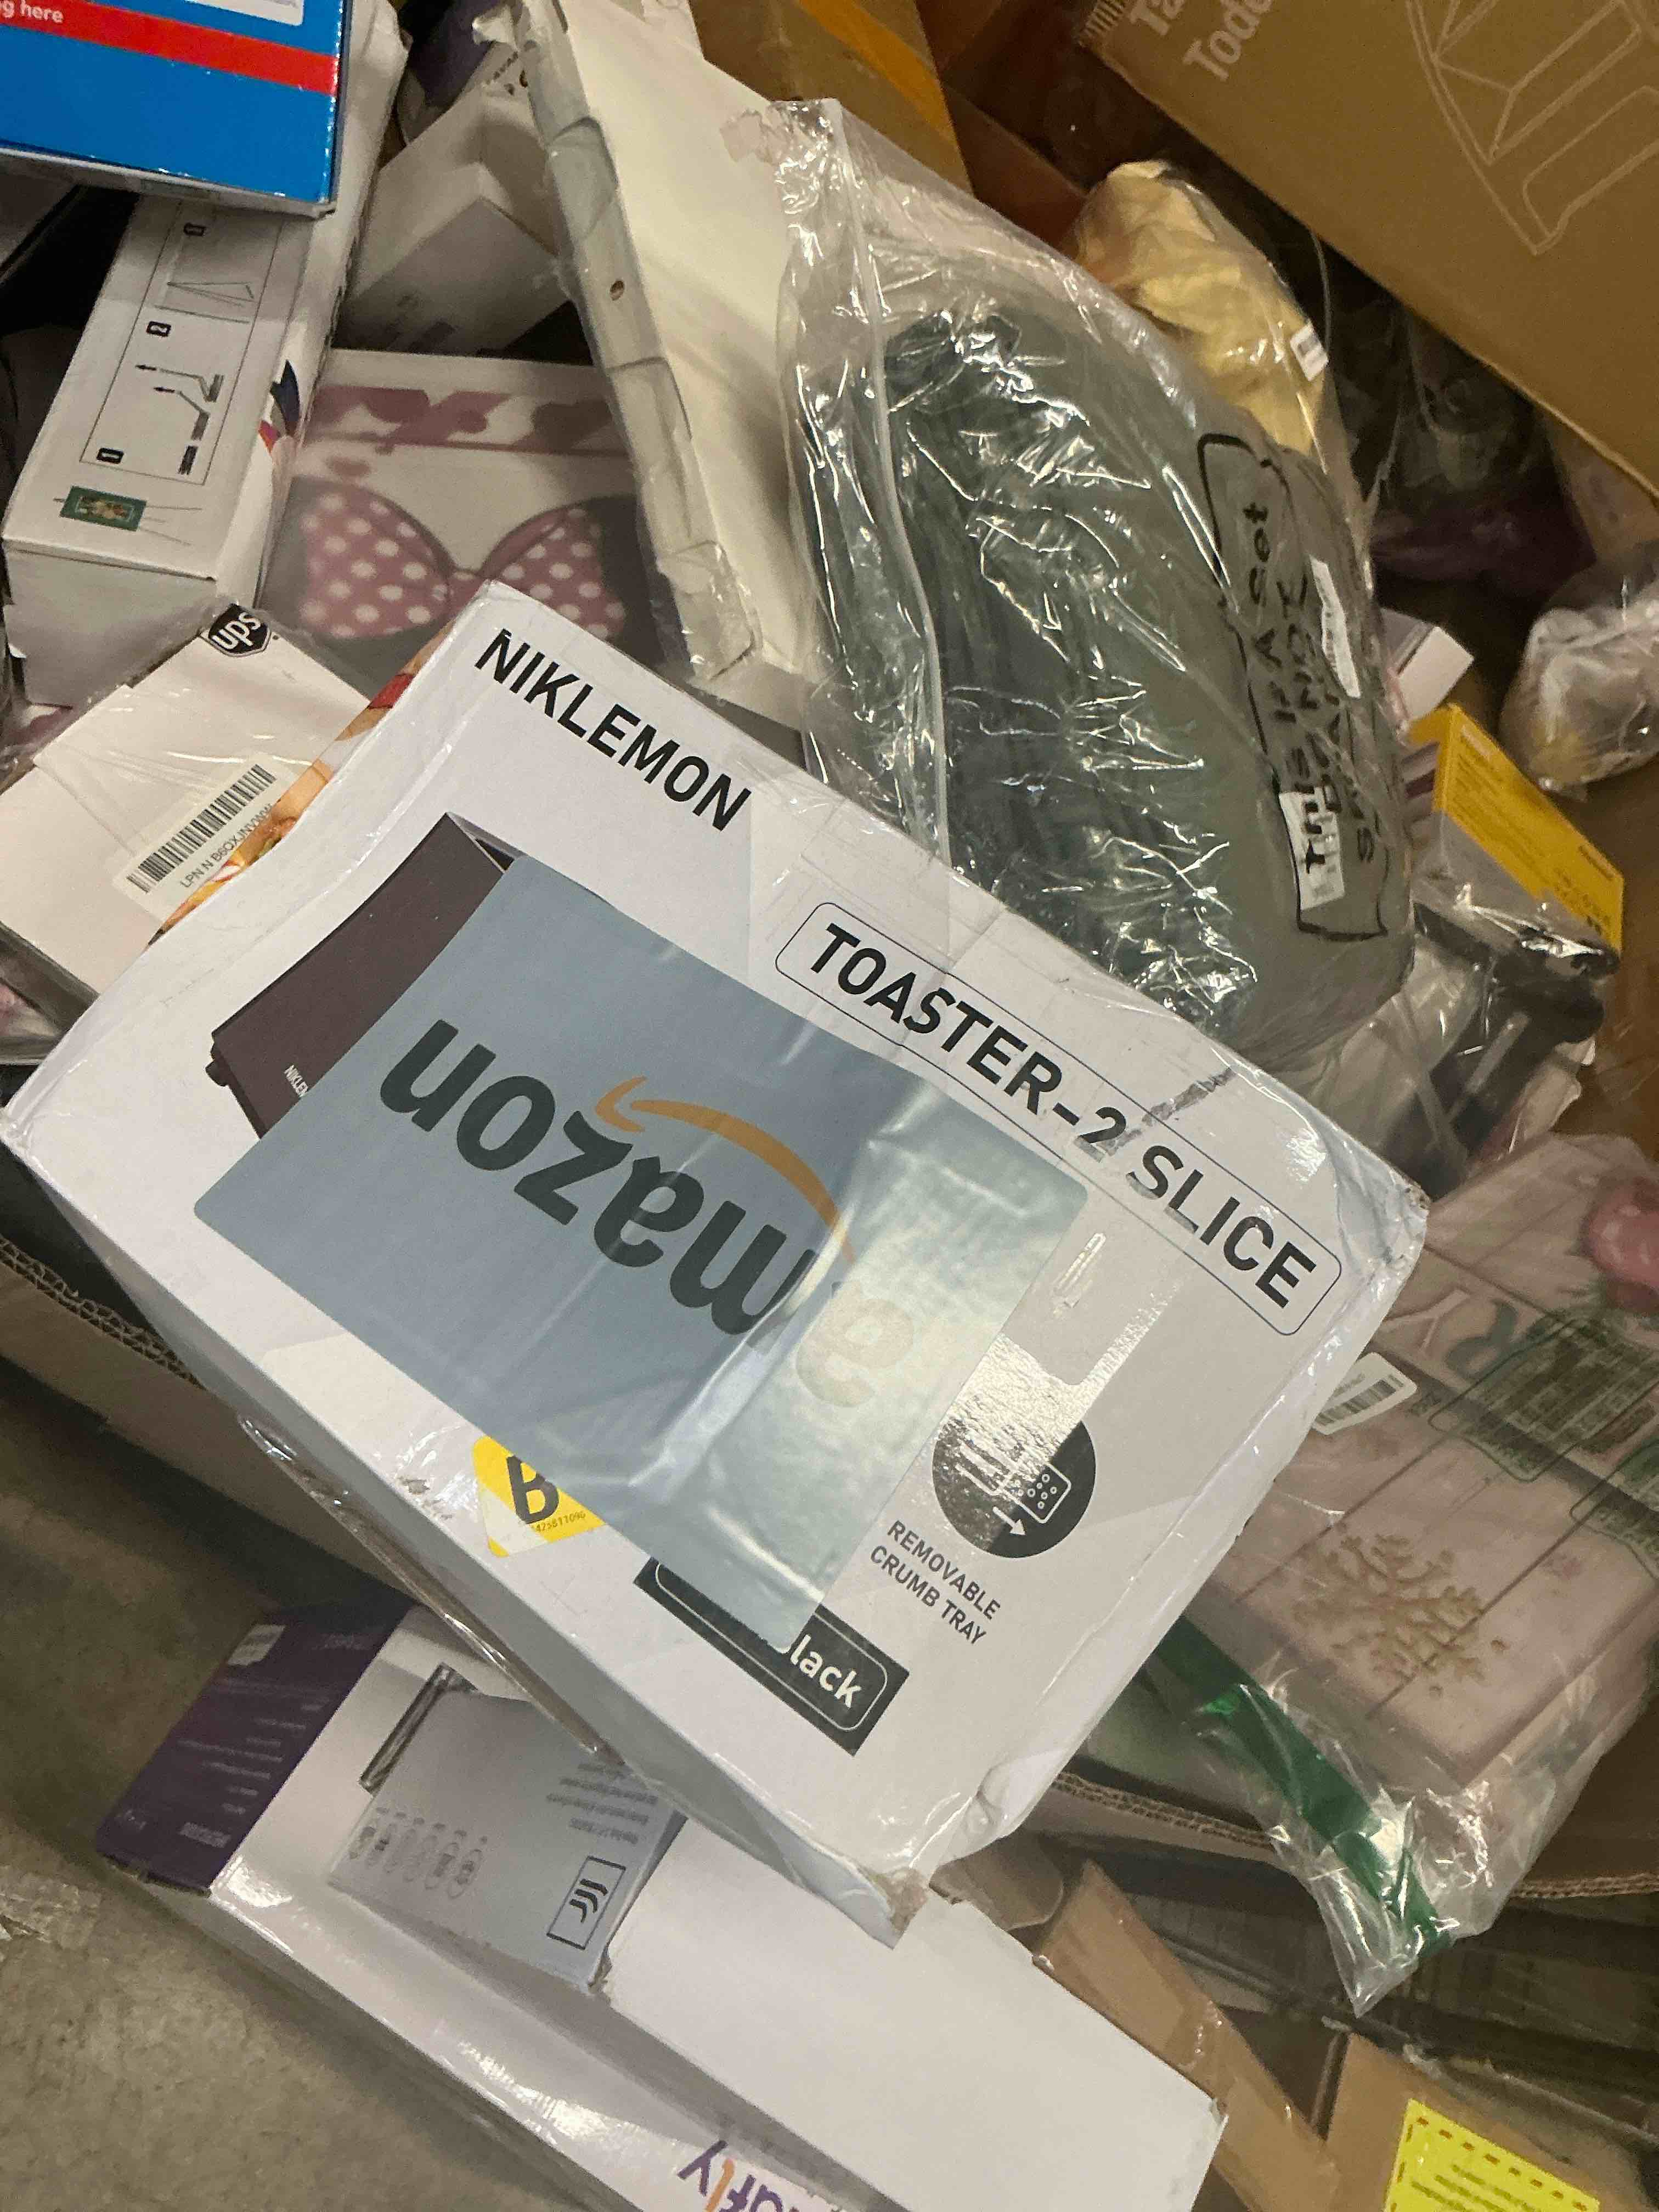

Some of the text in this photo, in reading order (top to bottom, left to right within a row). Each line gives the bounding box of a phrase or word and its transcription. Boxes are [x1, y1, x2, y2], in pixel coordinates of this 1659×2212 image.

[20, 0, 64, 24] here
[474, 628, 752, 832] NIKLEMON
[179, 866, 205, 888] LPN
[810, 923, 1318, 1310] TOASTER-2 SLICE
[380, 1019, 915, 1409] amazon
[506, 1455, 560, 1525] B
[870, 1545, 987, 1645] CRUMB TRAY
[887, 1520, 1001, 1620] REMOVABLE
[783, 1634, 862, 1708] lack
